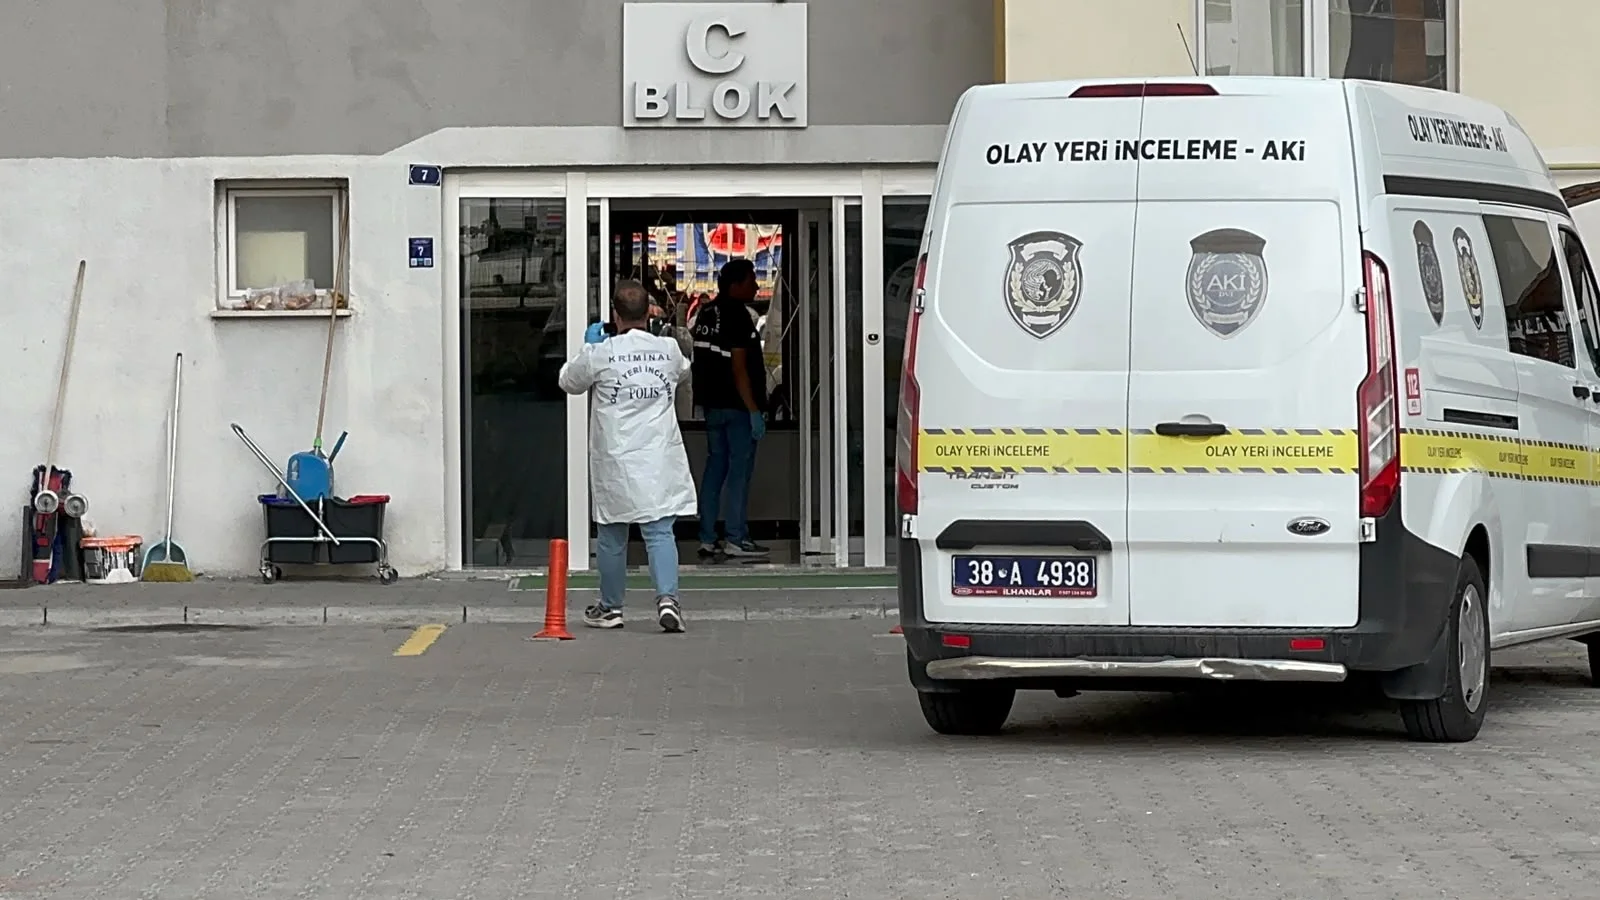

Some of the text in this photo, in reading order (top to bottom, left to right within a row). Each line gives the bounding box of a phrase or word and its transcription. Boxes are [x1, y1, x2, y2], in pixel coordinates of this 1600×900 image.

[686, 16, 746, 74] C
[635, 81, 797, 119] BLOK
[986, 142, 1047, 165] OLAY
[421, 169, 429, 181] 7
[610, 380, 622, 404] OLAY
[629, 384, 659, 400] POLİS
[1407, 373, 1419, 396] 112
[936, 445, 963, 456] OLAY
[1206, 446, 1238, 457] OLAY
[968, 560, 1089, 586] 38 A 4938
